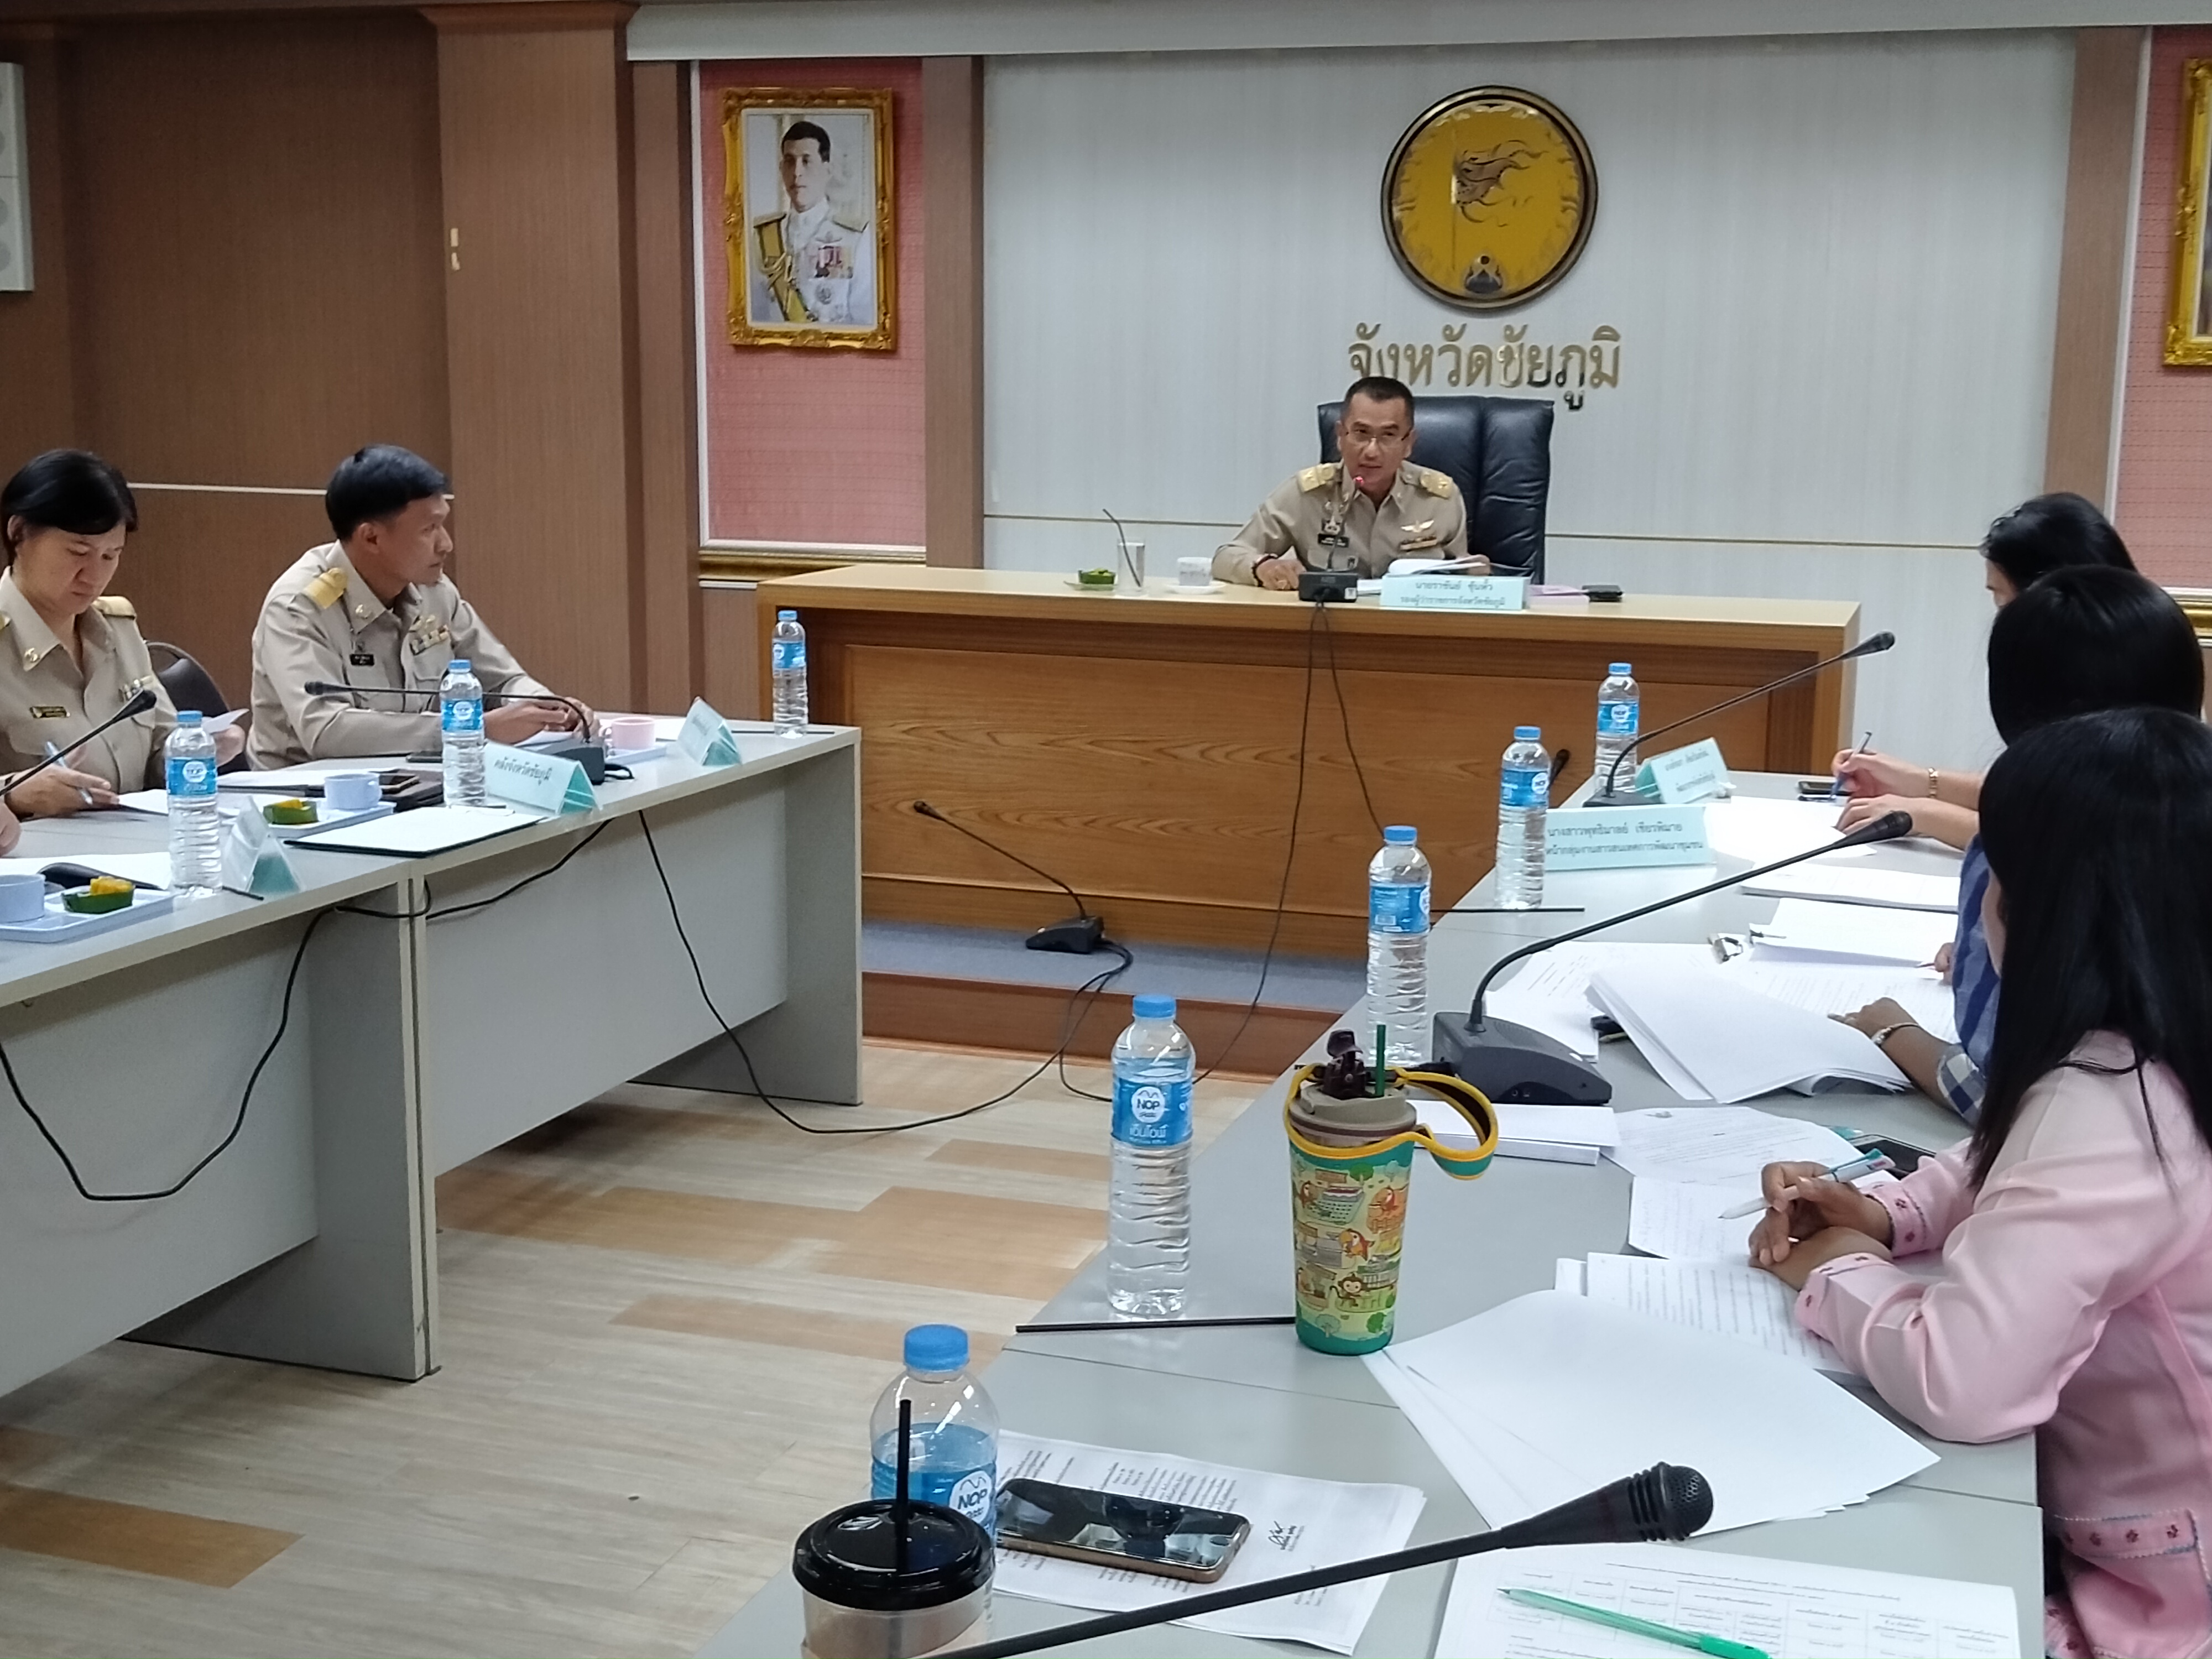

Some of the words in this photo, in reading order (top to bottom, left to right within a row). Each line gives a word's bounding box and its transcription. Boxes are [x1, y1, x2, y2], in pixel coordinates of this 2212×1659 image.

[1348, 322, 1621, 410] จังหวัดชัยภูมิ
[1136, 1098, 1161, 1110] NOP
[957, 1488, 988, 1510] NOP
